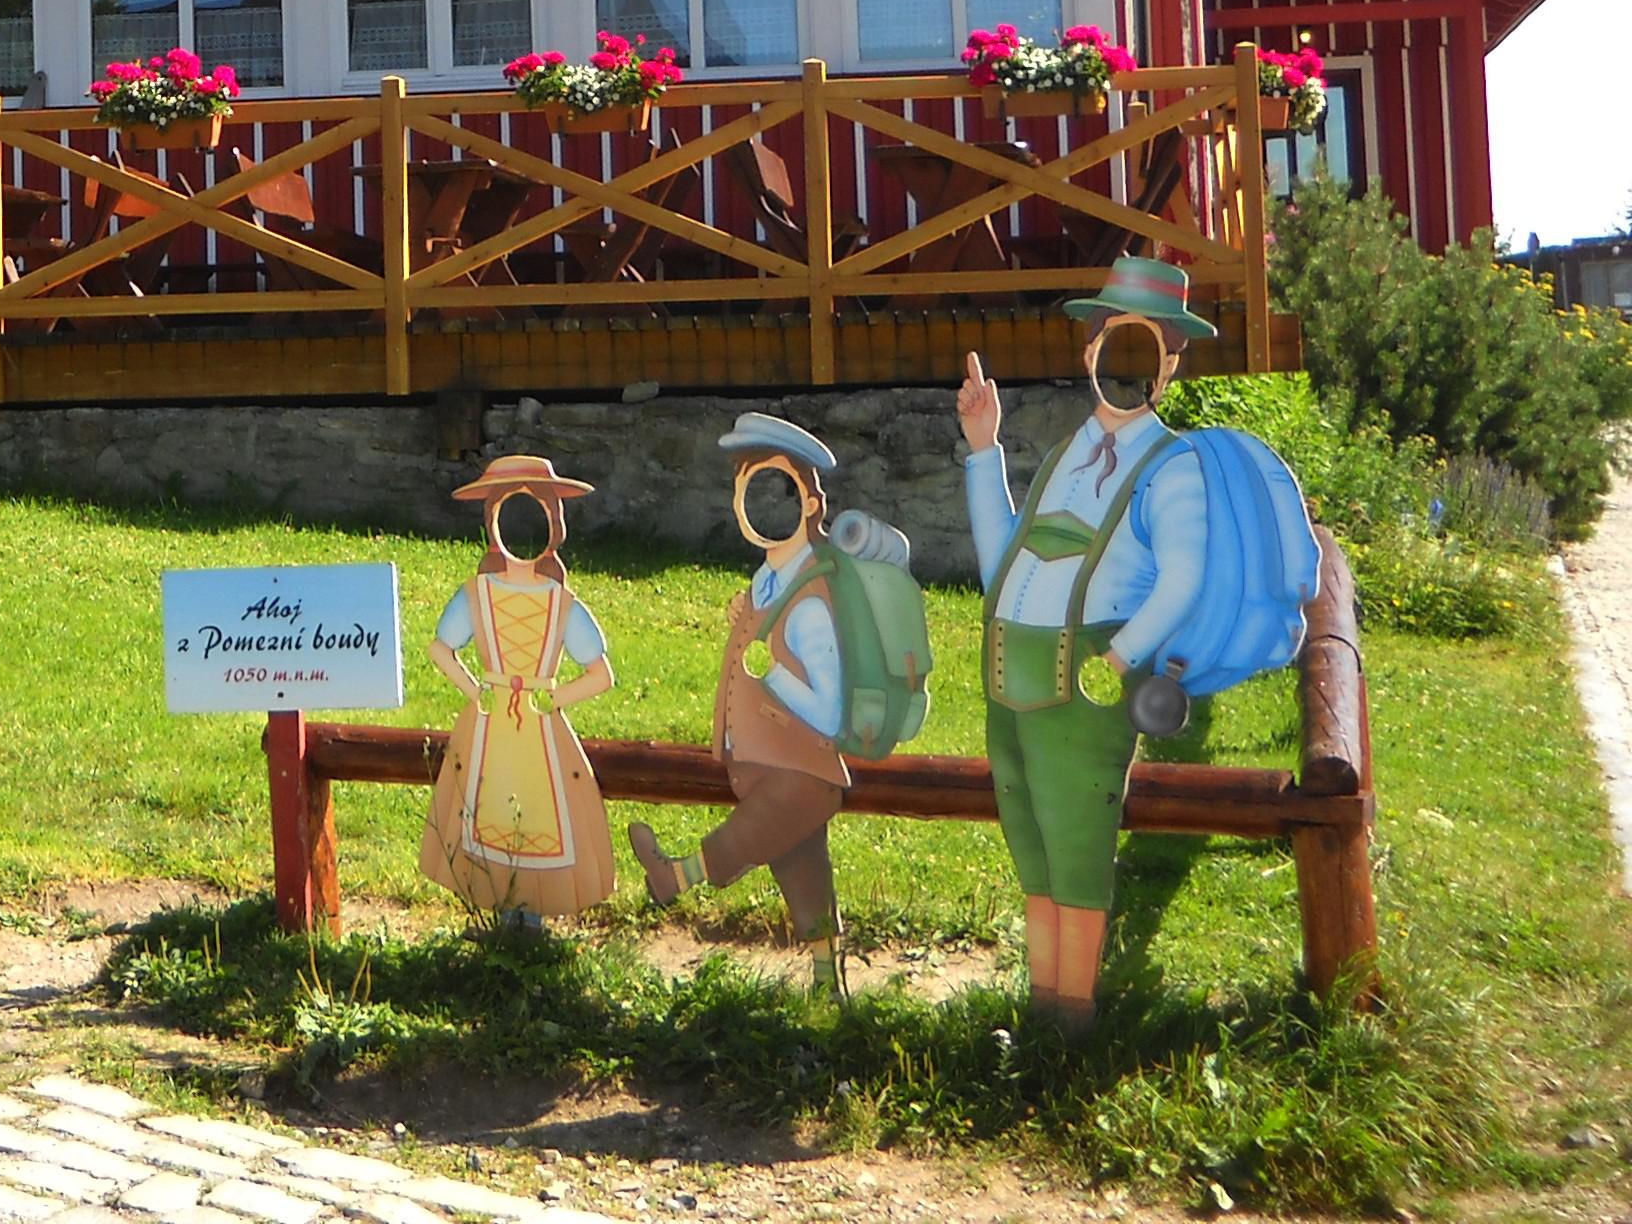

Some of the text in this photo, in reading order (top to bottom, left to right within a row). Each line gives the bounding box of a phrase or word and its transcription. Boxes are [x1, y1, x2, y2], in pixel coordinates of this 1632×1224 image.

[241, 596, 302, 624] Ahoj
[198, 625, 306, 659] Pomezní
[312, 623, 380, 657] boudy
[224, 668, 267, 683] 1050
